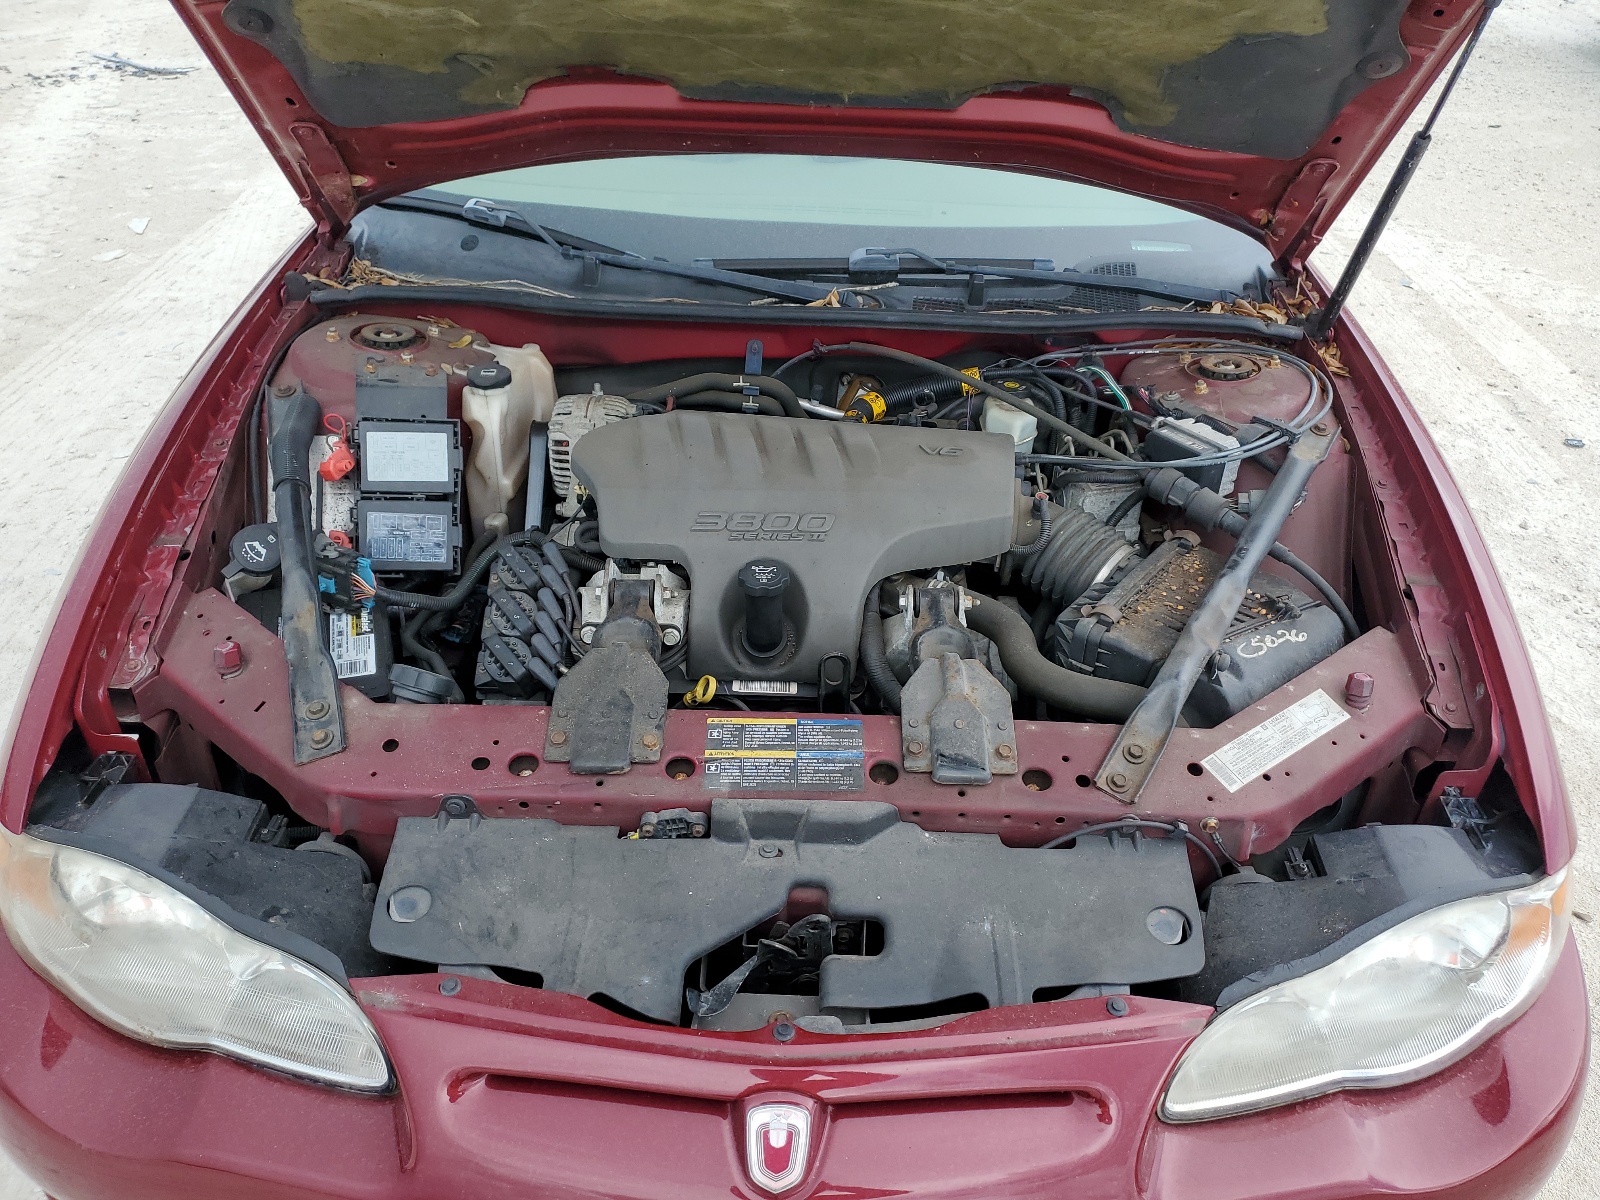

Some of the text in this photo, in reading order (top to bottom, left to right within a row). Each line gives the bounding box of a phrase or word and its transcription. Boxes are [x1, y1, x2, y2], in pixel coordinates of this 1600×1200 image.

[918, 443, 964, 458] V6
[690, 511, 837, 533] 3800
[728, 532, 828, 542] SERIES II
